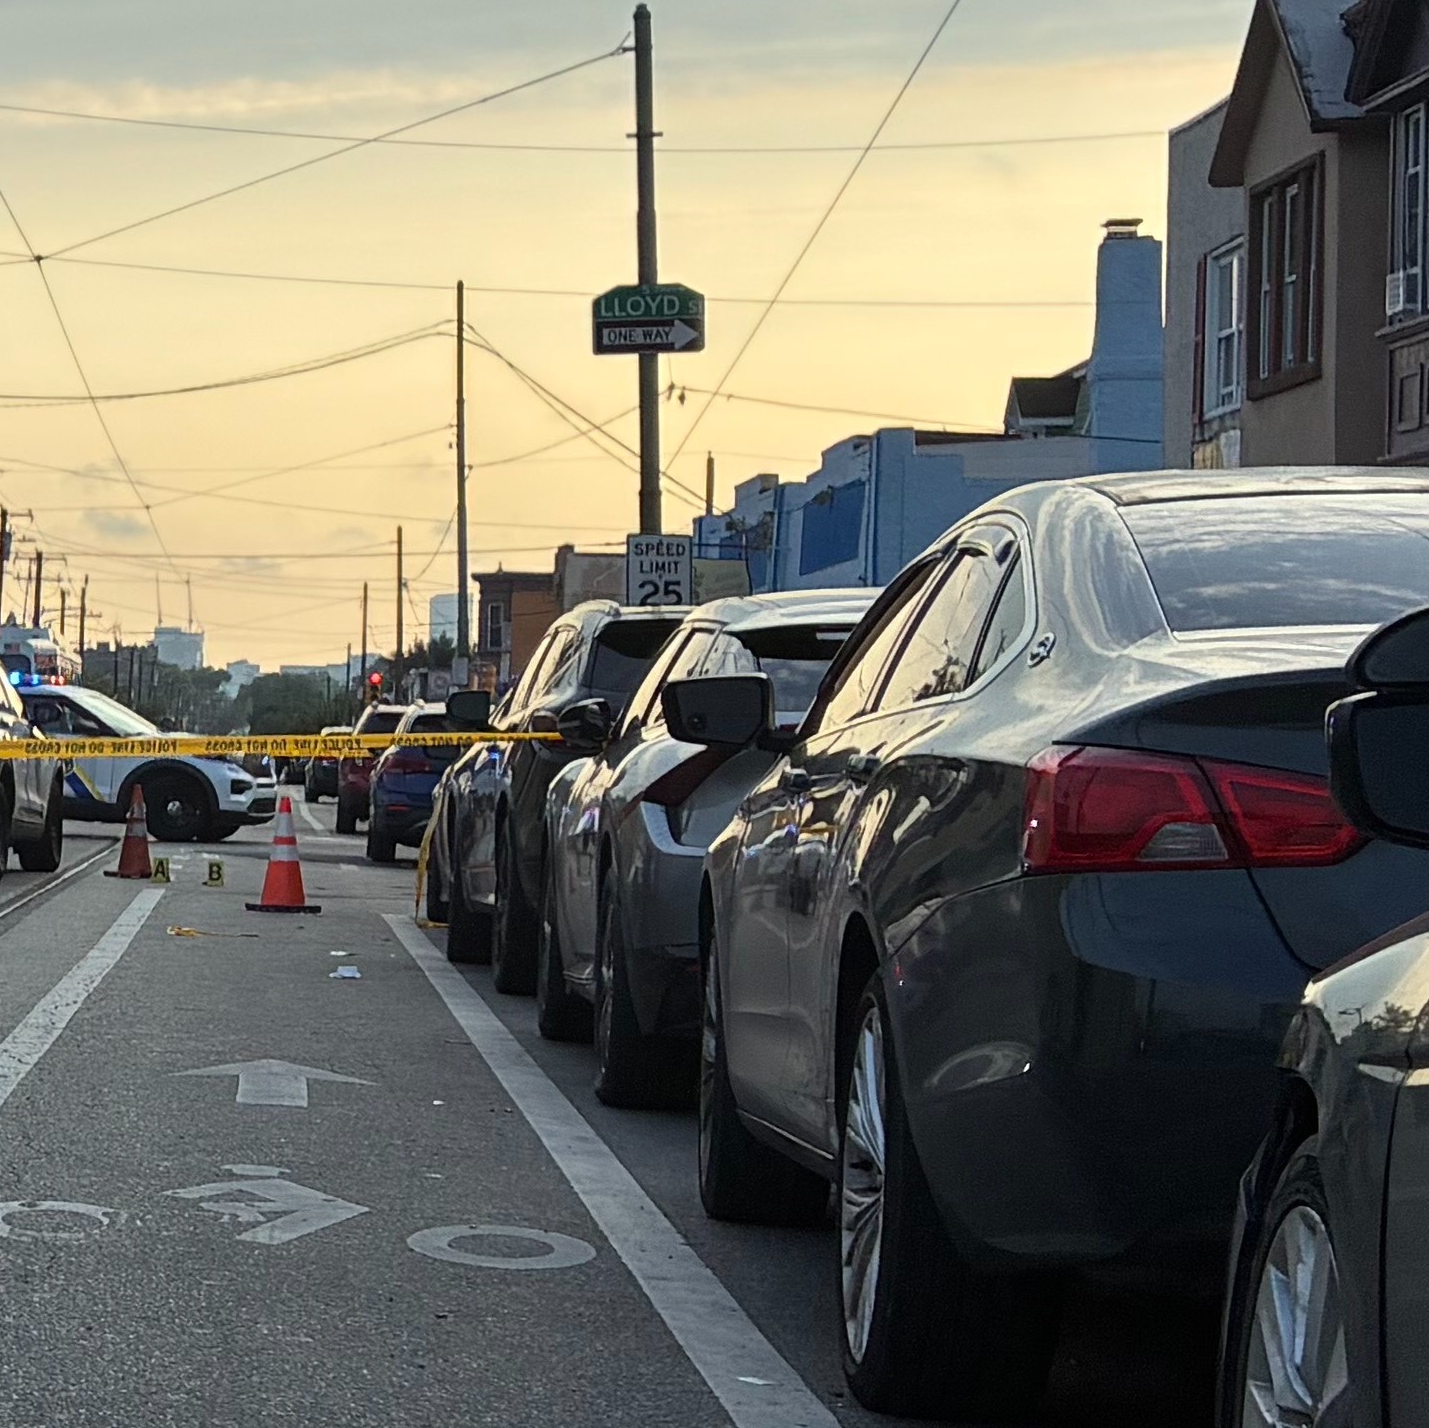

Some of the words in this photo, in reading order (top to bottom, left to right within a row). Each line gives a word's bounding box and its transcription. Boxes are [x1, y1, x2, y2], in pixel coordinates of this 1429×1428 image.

[601, 295, 680, 317] LLOYD
[608, 328, 637, 342] ONE
[642, 327, 672, 342] WAY
[634, 542, 685, 556] SPEED
[640, 561, 680, 574] LIMIT
[639, 580, 682, 605] 25
[154, 860, 166, 877] A
[209, 862, 222, 881] B
